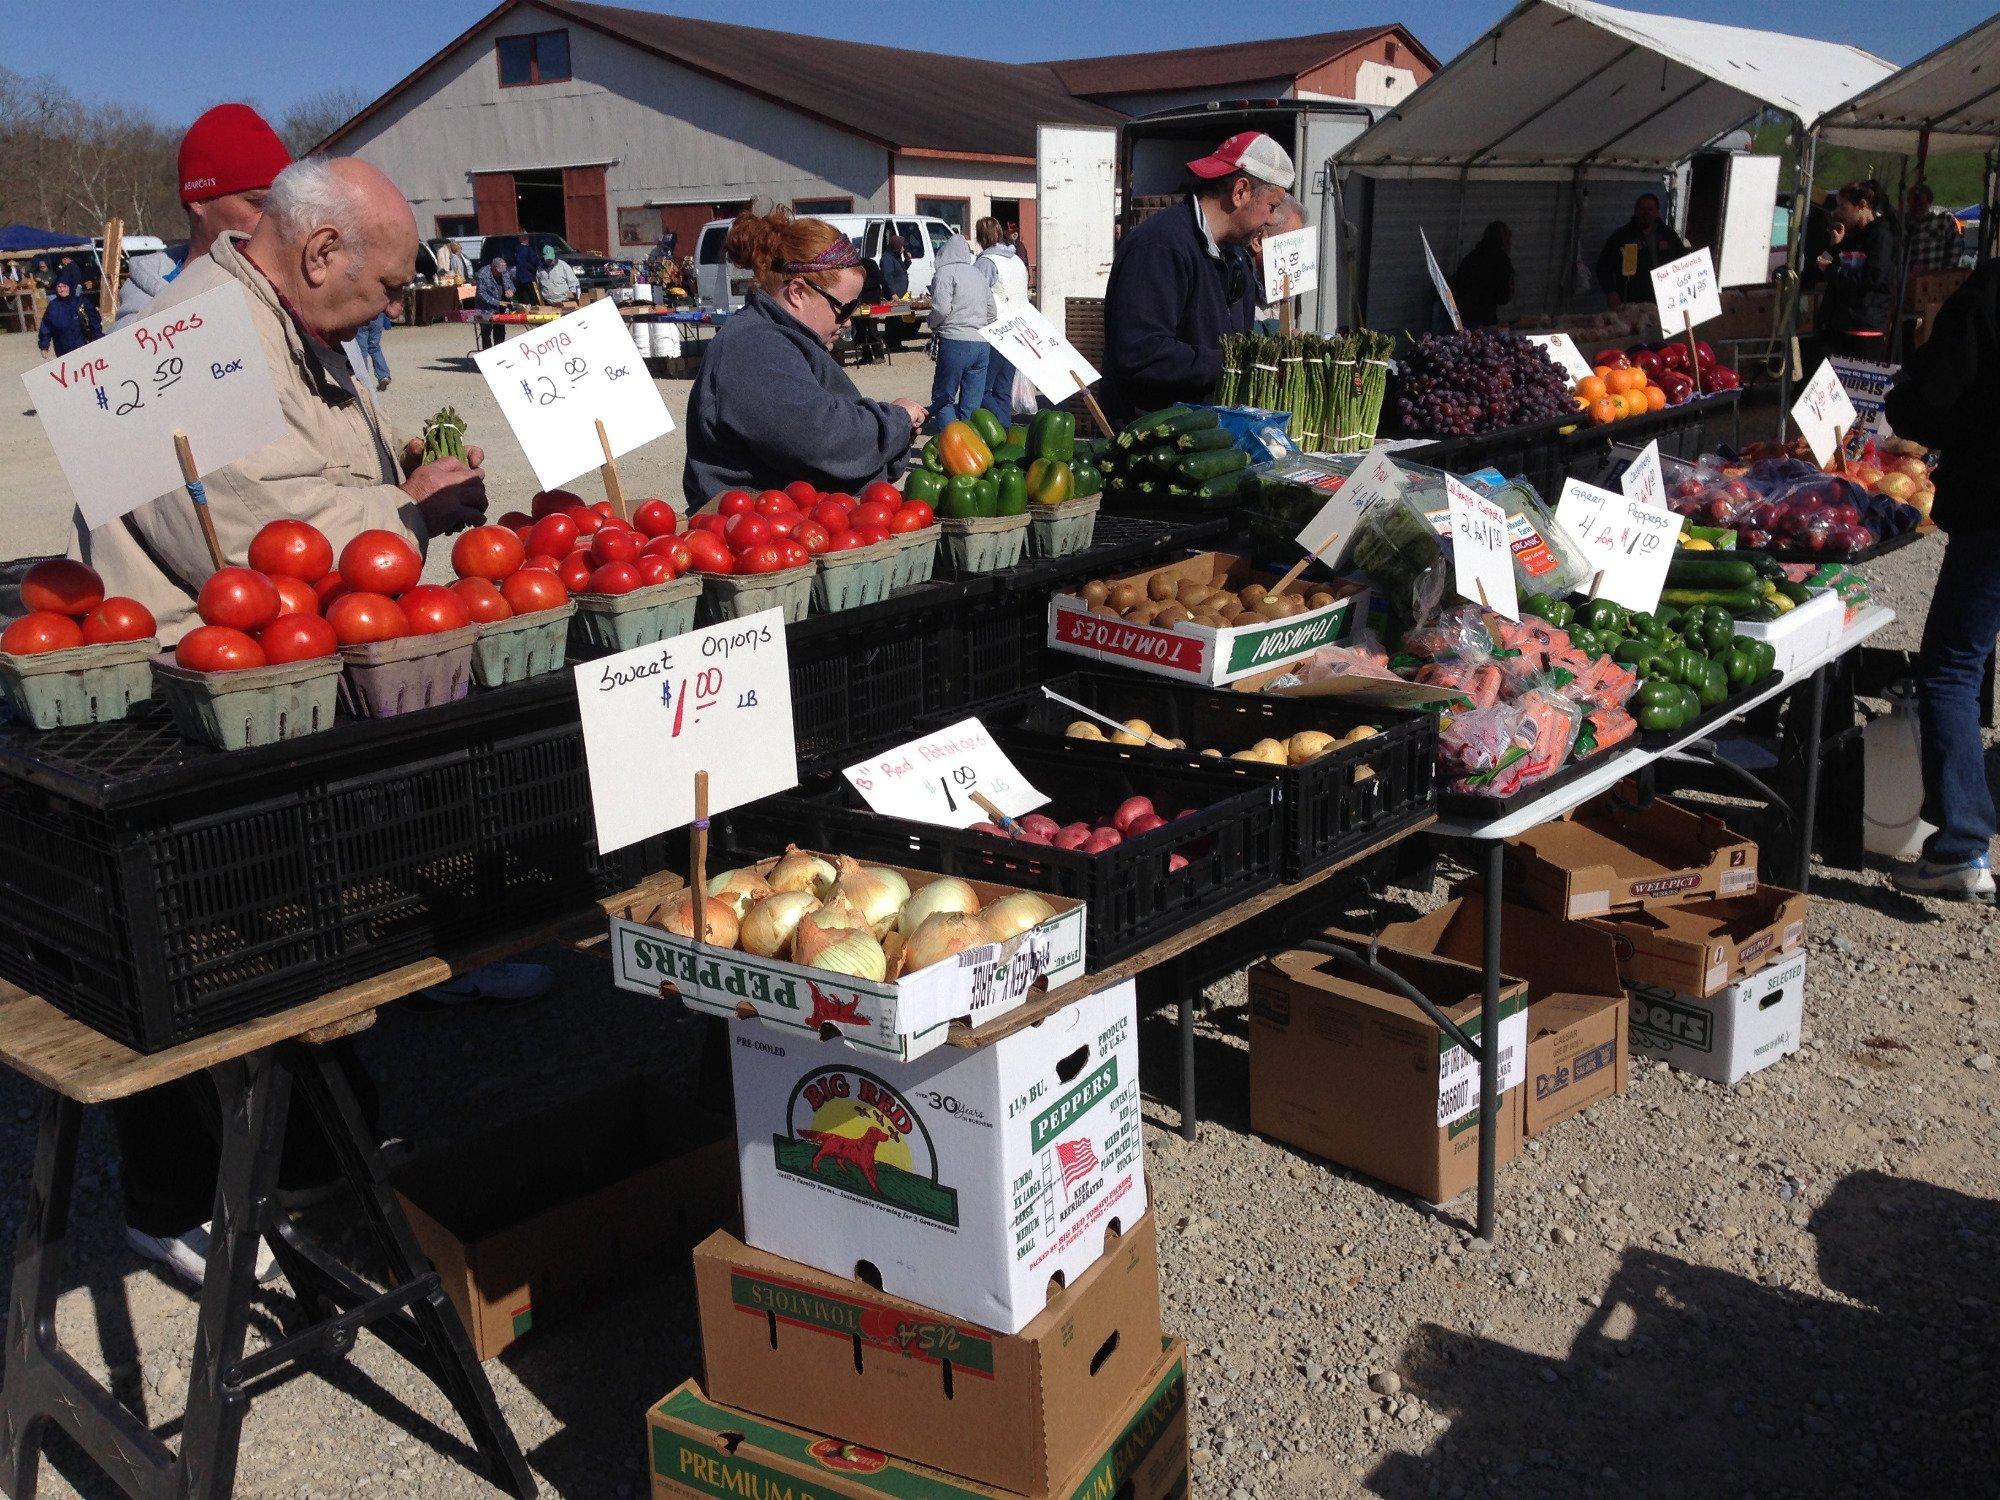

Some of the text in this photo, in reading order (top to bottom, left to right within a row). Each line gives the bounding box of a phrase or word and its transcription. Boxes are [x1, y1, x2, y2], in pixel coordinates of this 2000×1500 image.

[210, 358, 244, 380] Box
[604, 365, 630, 381] Box
[1461, 513, 1472, 538] 2
[1578, 515, 1596, 538] 4
[1511, 536, 1540, 552] ORGANIC
[1071, 618, 1183, 662] TOMATOES
[1251, 613, 1339, 663] JOHNSON
[599, 625, 772, 692] Sweet Onions
[737, 689, 759, 709] LB
[880, 756, 914, 780] Red
[633, 939, 800, 1011] PEPPERS
[1767, 965, 1802, 991] SELECTED
[1742, 988, 1753, 1003] 24
[1097, 1015, 1129, 1047] PRODUCE
[736, 1035, 787, 1058] PRE-COOLED
[1099, 1042, 1109, 1058] OF
[1029, 1079, 1048, 1104] BU.
[1537, 1065, 1569, 1100] Dole
[803, 1073, 913, 1132] BIG RED
[928, 1090, 958, 1115] 30
[1037, 1067, 1113, 1141] PEPPERS
[1119, 1105, 1130, 1121] RED
[1120, 1121, 1131, 1136] RED
[1012, 1168, 1033, 1197] JUMBO
[1023, 1179, 1042, 1203] LARGE
[1073, 1179, 1091, 1200] KEEP
[1059, 1177, 1104, 1223] REFRIGERATED
[1071, 1215, 1086, 1236] RED
[1085, 1195, 1110, 1222] TOMATO
[1016, 1215, 1041, 1245] MEDIUM
[1016, 1237, 1036, 1261] SMALL
[751, 1283, 857, 1330] TOMATOES
[897, 1321, 960, 1351] USA
[679, 1447, 792, 1500] PREMIUM
